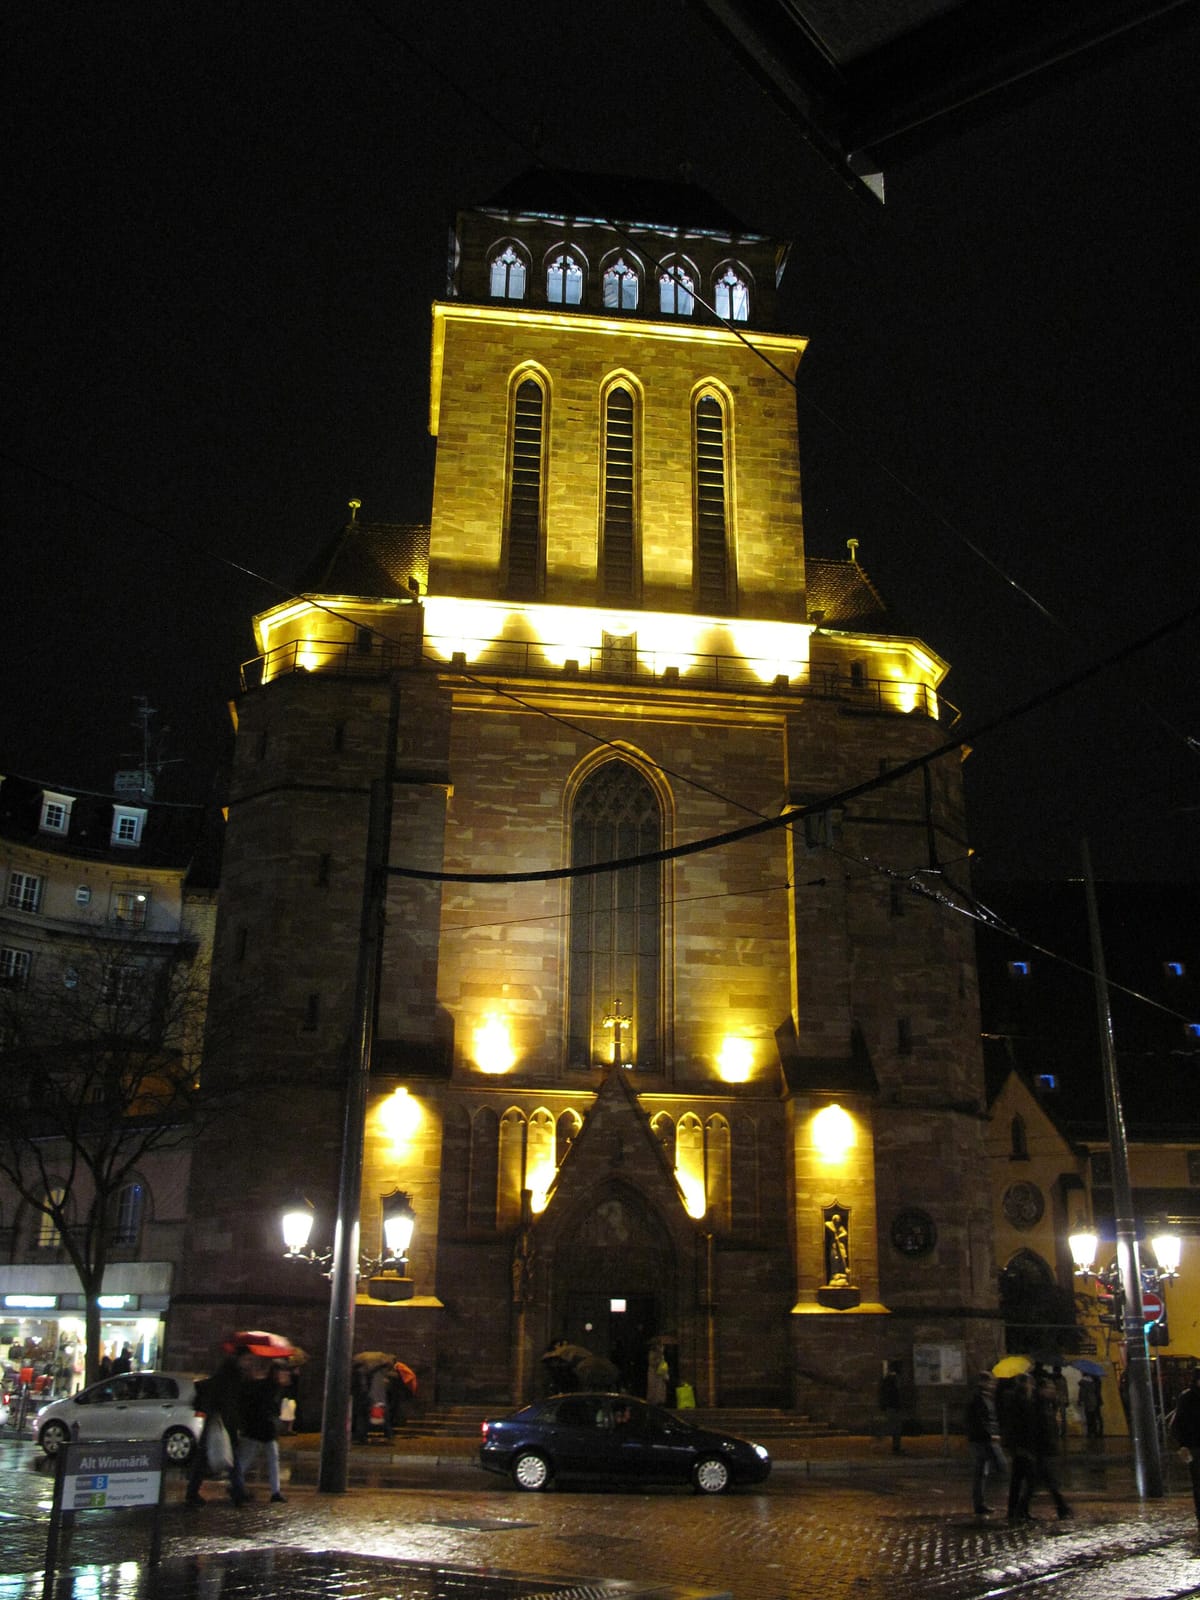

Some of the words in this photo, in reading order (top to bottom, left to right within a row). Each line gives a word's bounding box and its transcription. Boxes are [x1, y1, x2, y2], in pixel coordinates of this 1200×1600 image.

[79, 1457, 97, 1469] Alt
[96, 1477, 104, 1488] B
[95, 1493, 102, 1504] F
